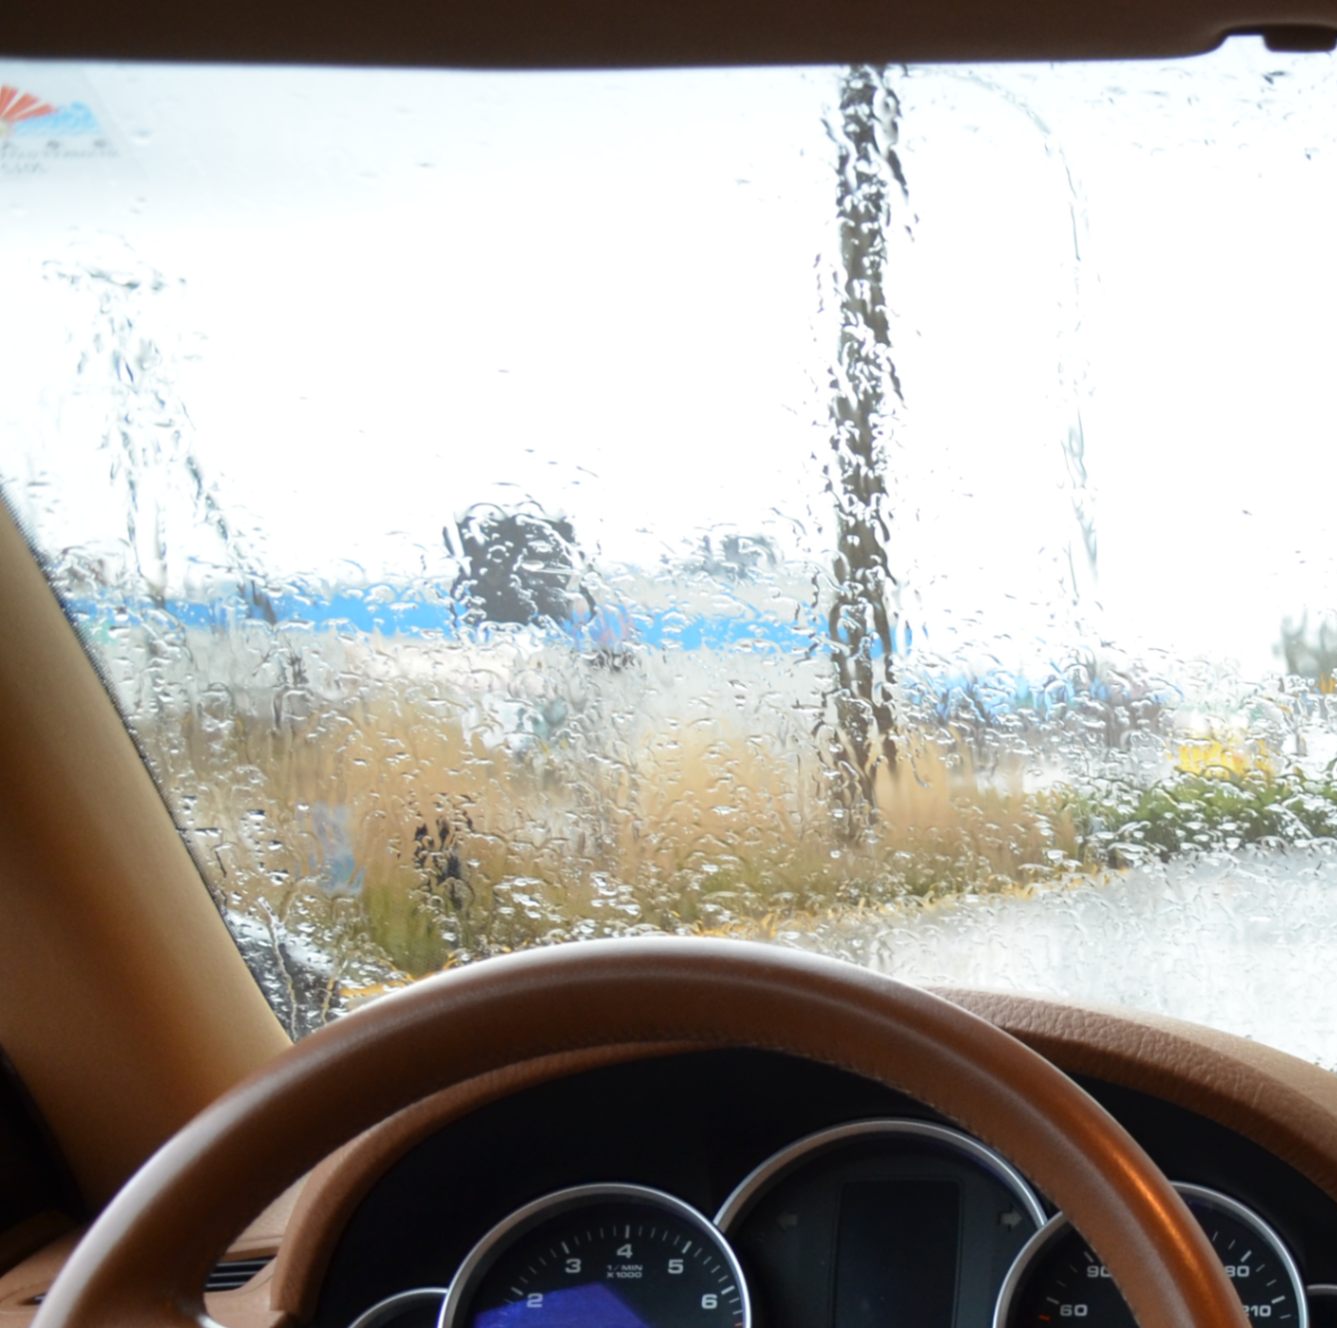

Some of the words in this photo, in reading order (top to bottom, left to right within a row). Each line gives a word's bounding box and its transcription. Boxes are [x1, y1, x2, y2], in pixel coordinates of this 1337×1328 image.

[616, 1243, 634, 1259] 4
[564, 1258, 582, 1274] 3
[667, 1258, 685, 1275] 5
[526, 1293, 544, 1308] 2
[701, 1293, 718, 1310] 6
[1059, 1304, 1089, 1317] 60
